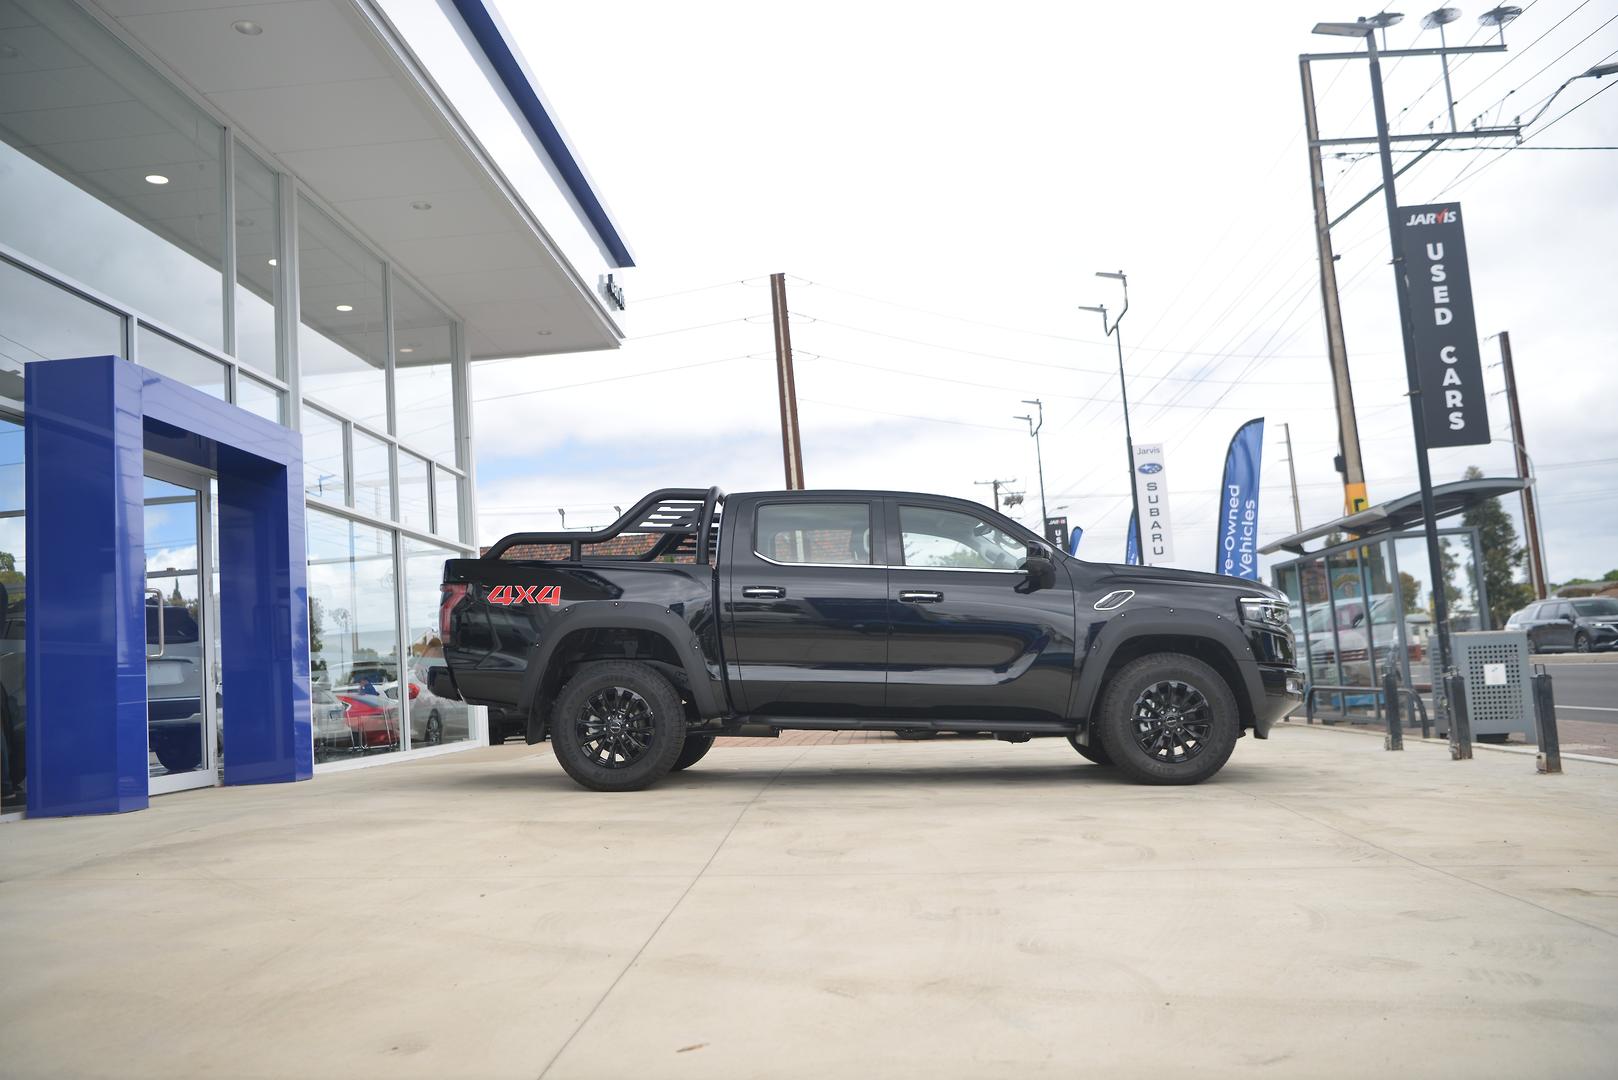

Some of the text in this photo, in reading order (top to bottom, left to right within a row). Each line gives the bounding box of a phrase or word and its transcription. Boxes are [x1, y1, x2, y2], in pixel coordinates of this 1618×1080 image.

[1406, 208, 1457, 226] JARVIS
[1426, 242, 1465, 430] USED CARS
[1137, 446, 1161, 456] Jarvis
[1146, 482, 1164, 556] SUBARU
[1224, 484, 1240, 576] re-Owned
[1239, 499, 1256, 577] Vehicles
